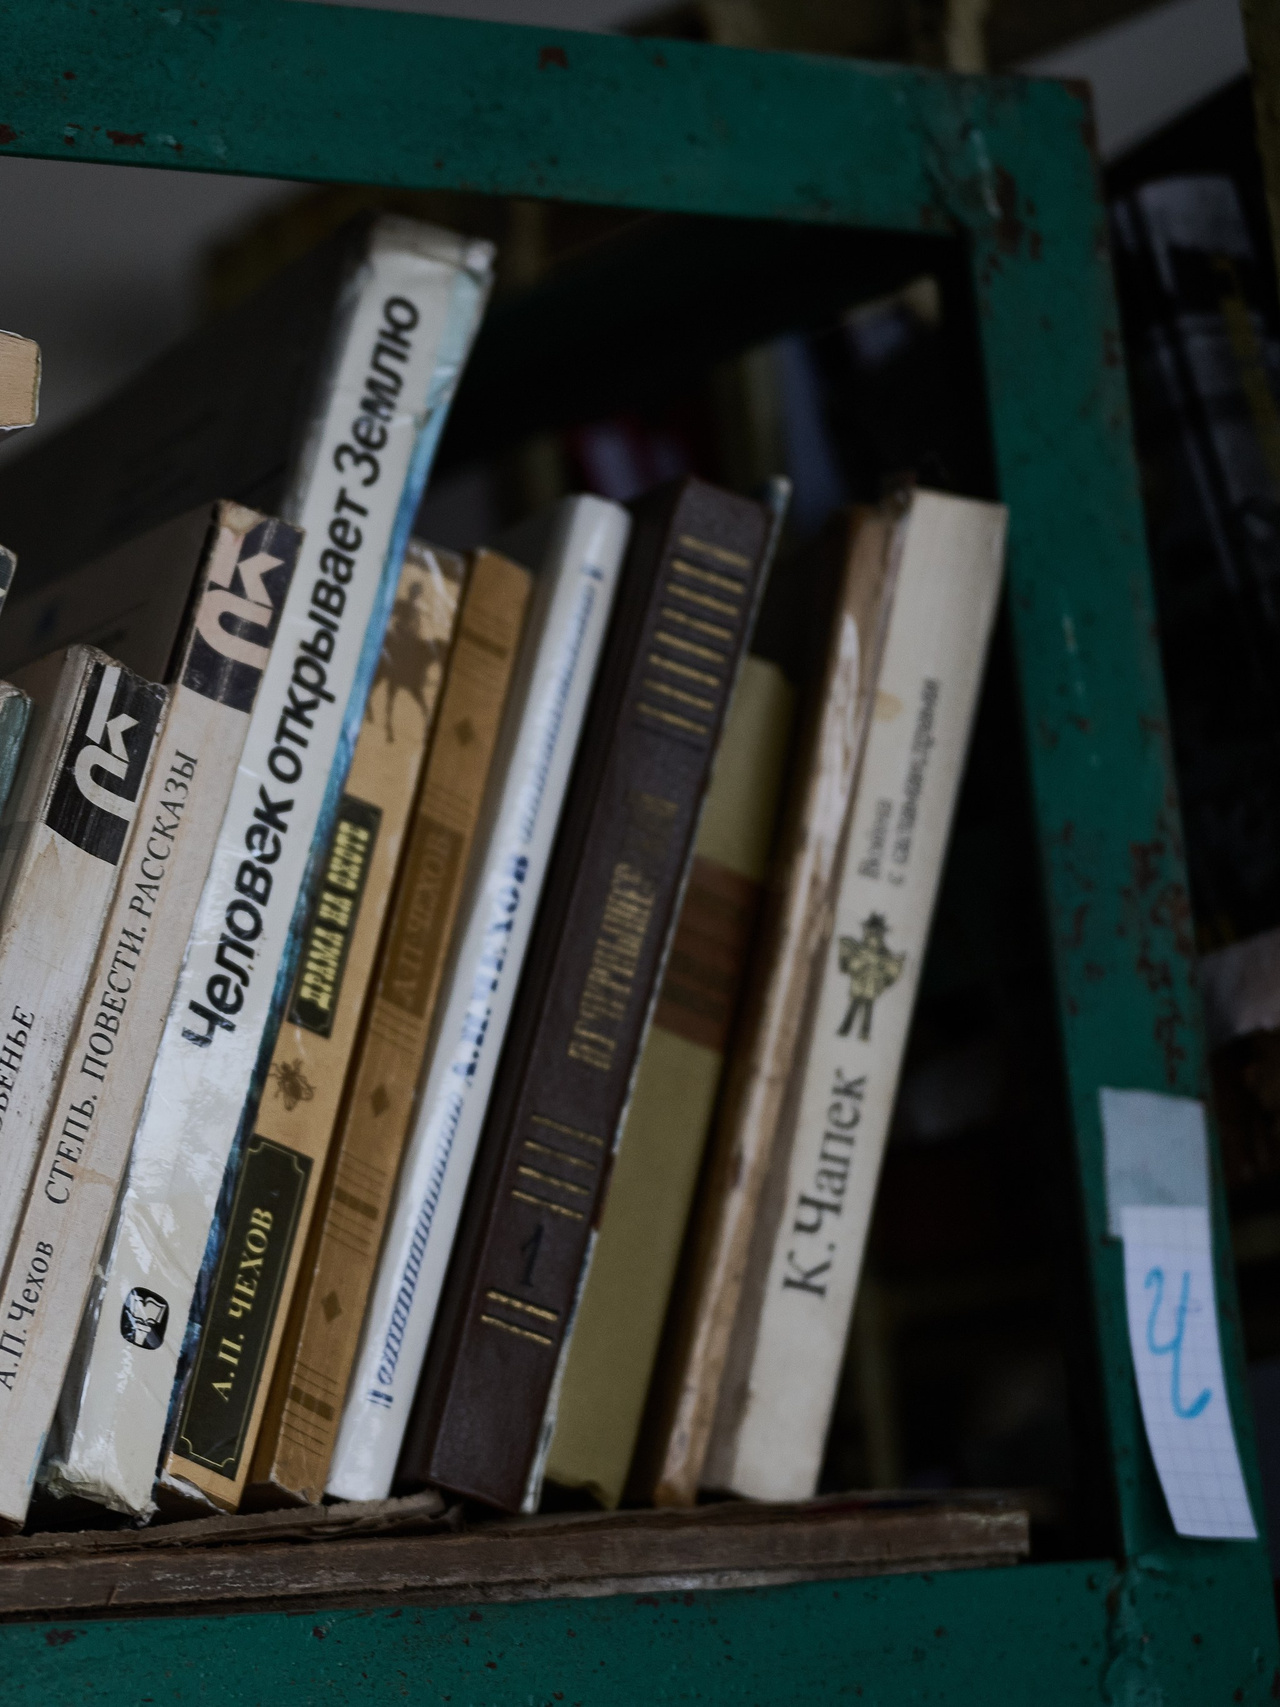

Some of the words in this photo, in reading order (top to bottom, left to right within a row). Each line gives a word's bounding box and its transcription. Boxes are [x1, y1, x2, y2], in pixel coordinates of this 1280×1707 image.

[182, 787, 294, 1048] Человек
[267, 487, 369, 785] открывает
[334, 297, 420, 488] Землю
[45, 1096, 98, 1205] СТЕПЬ.
[82, 924, 145, 1082] ПОВЕСТИ.
[130, 749, 199, 921] РАССКАЗЫ
